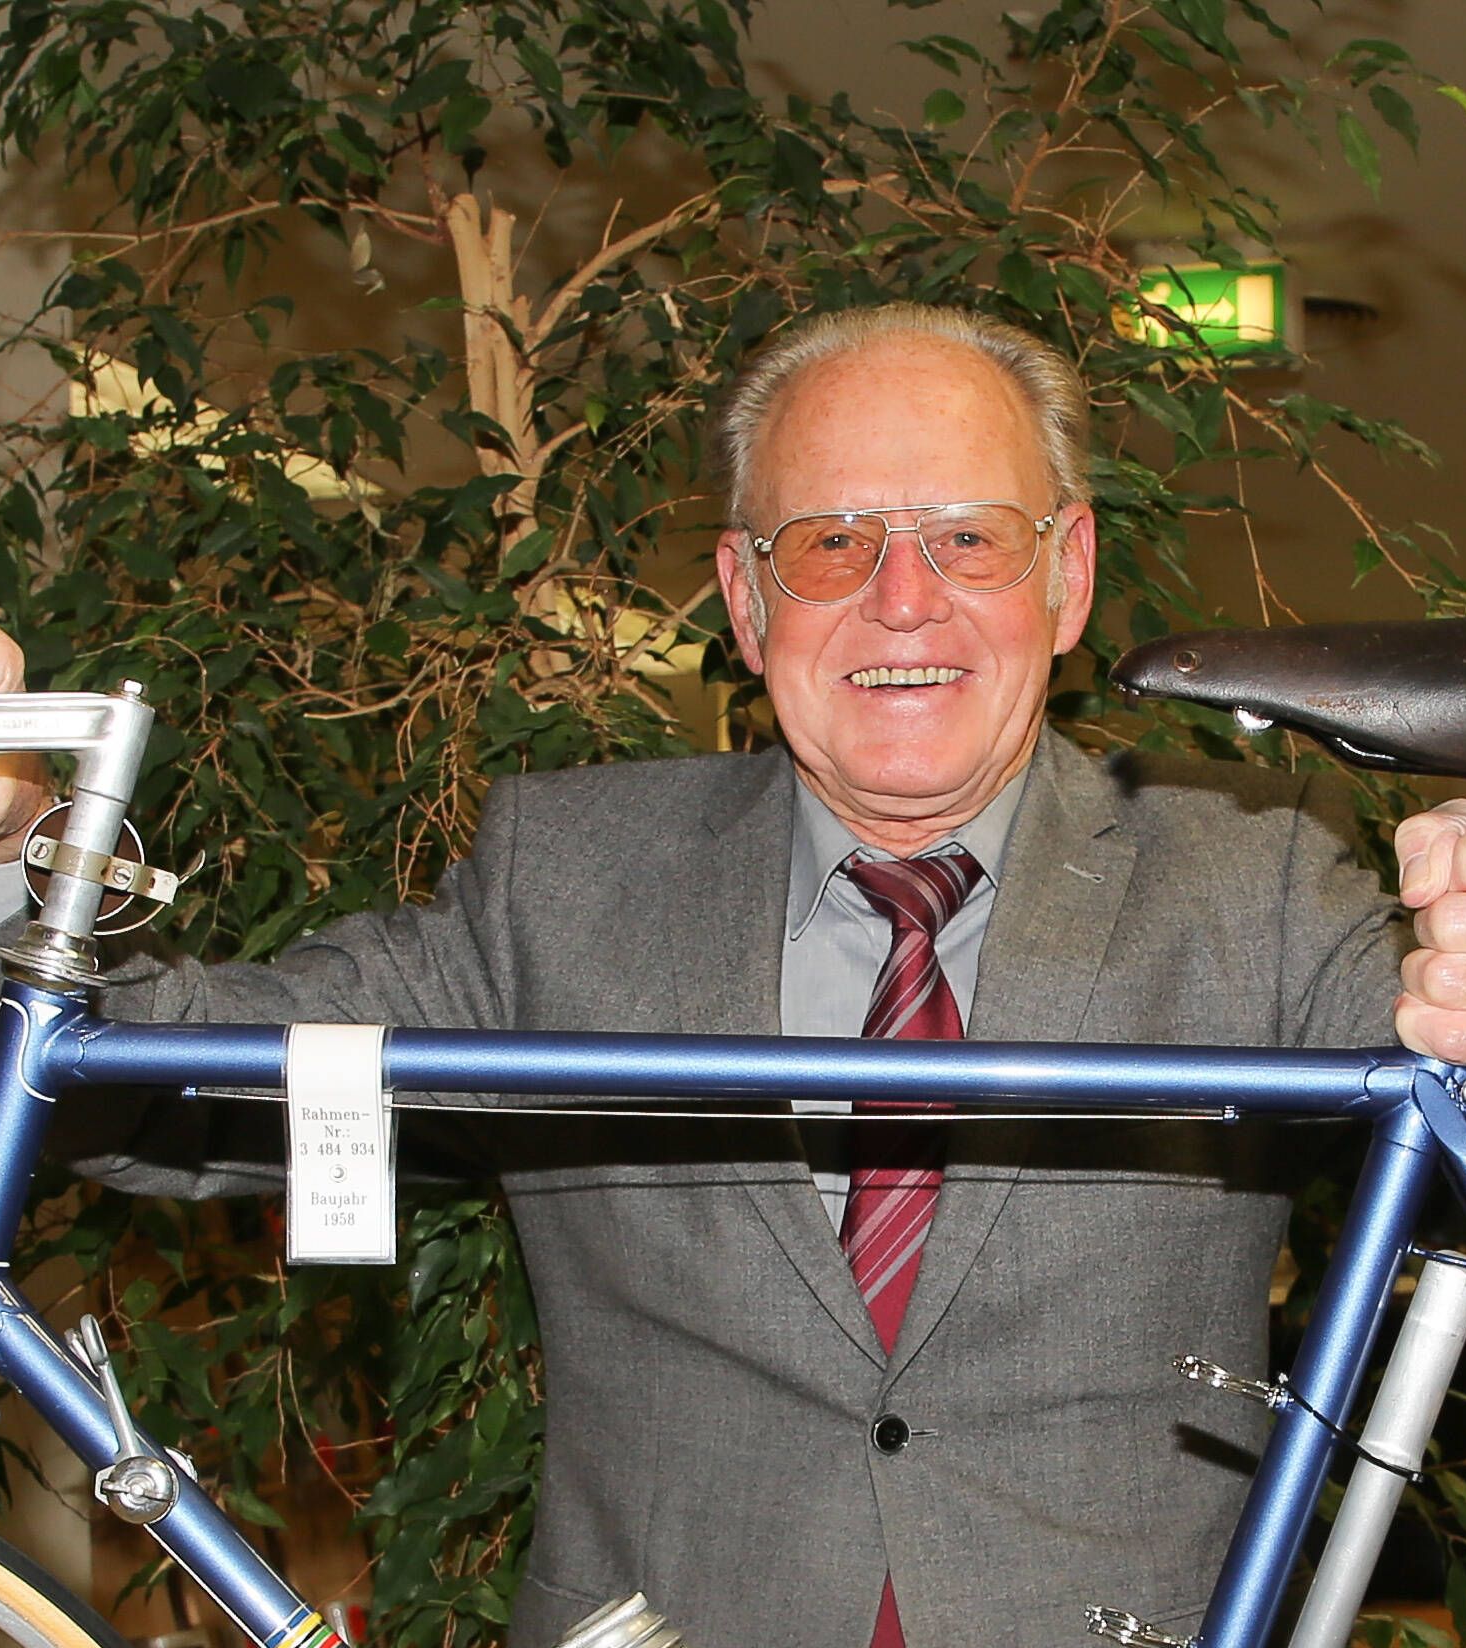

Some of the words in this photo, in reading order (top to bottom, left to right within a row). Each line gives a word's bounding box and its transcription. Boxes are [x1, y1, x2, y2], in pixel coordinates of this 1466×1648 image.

[301, 1107, 371, 1121] Rahmen-
[324, 1125, 350, 1138] Nr.:
[317, 1142, 342, 1156] 484
[351, 1142, 376, 1156] 934
[311, 1191, 368, 1209] Baujahr
[324, 1211, 356, 1227] 1958
